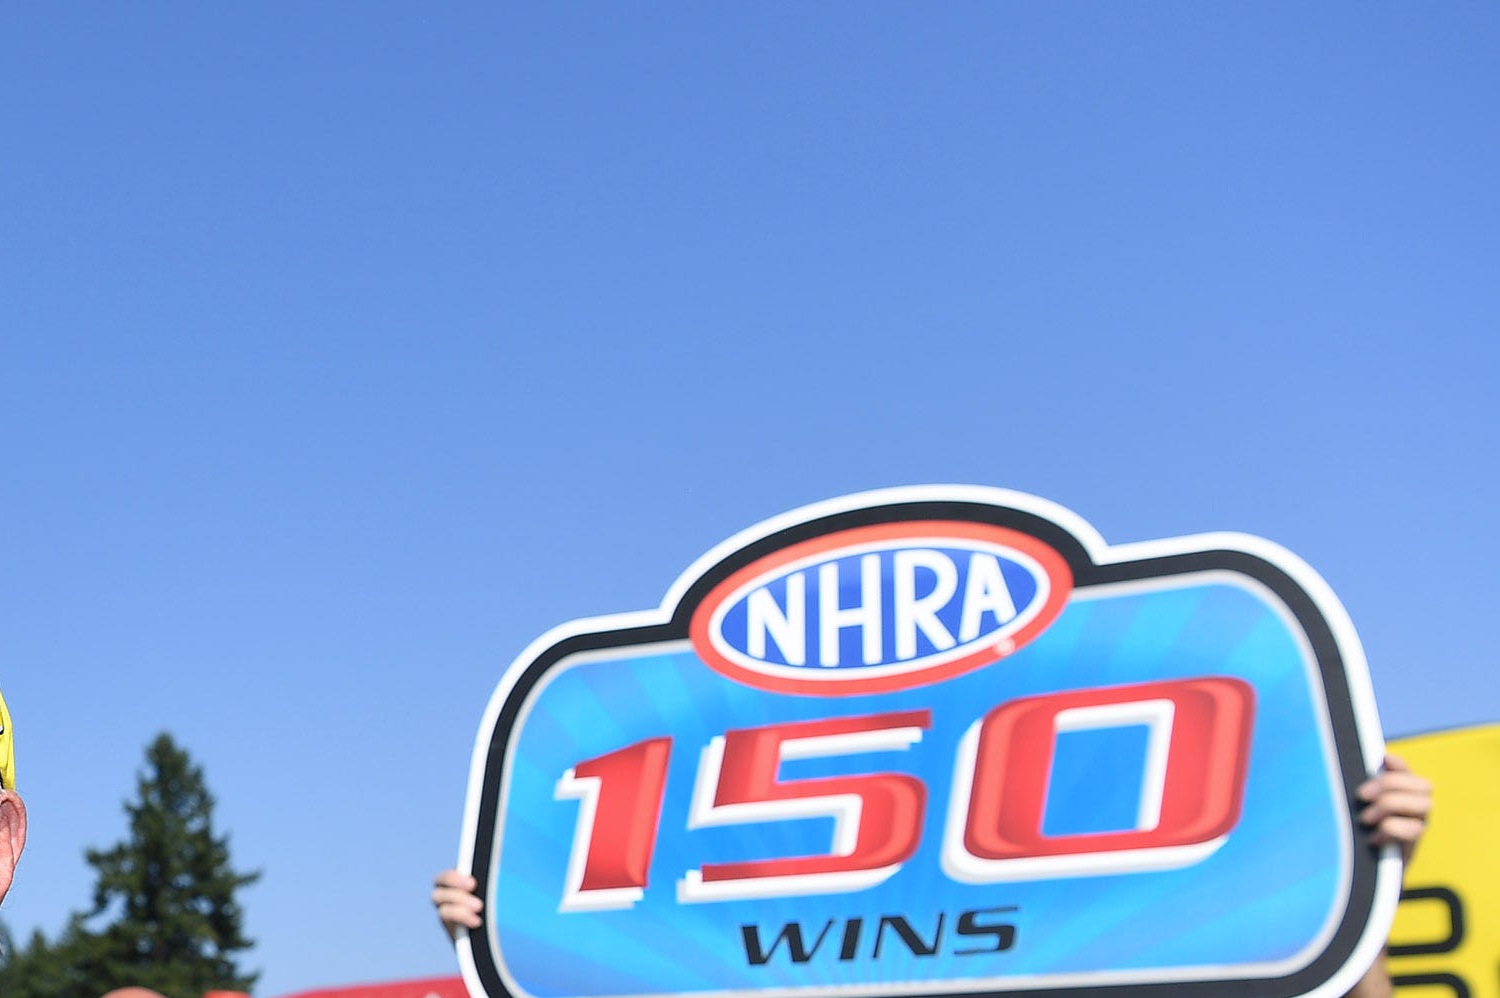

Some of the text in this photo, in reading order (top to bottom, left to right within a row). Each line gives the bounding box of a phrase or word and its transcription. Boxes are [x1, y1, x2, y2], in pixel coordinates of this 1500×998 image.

[746, 548, 1017, 667] NHRA
[556, 676, 1257, 916] 150
[741, 906, 1019, 966] WINS
